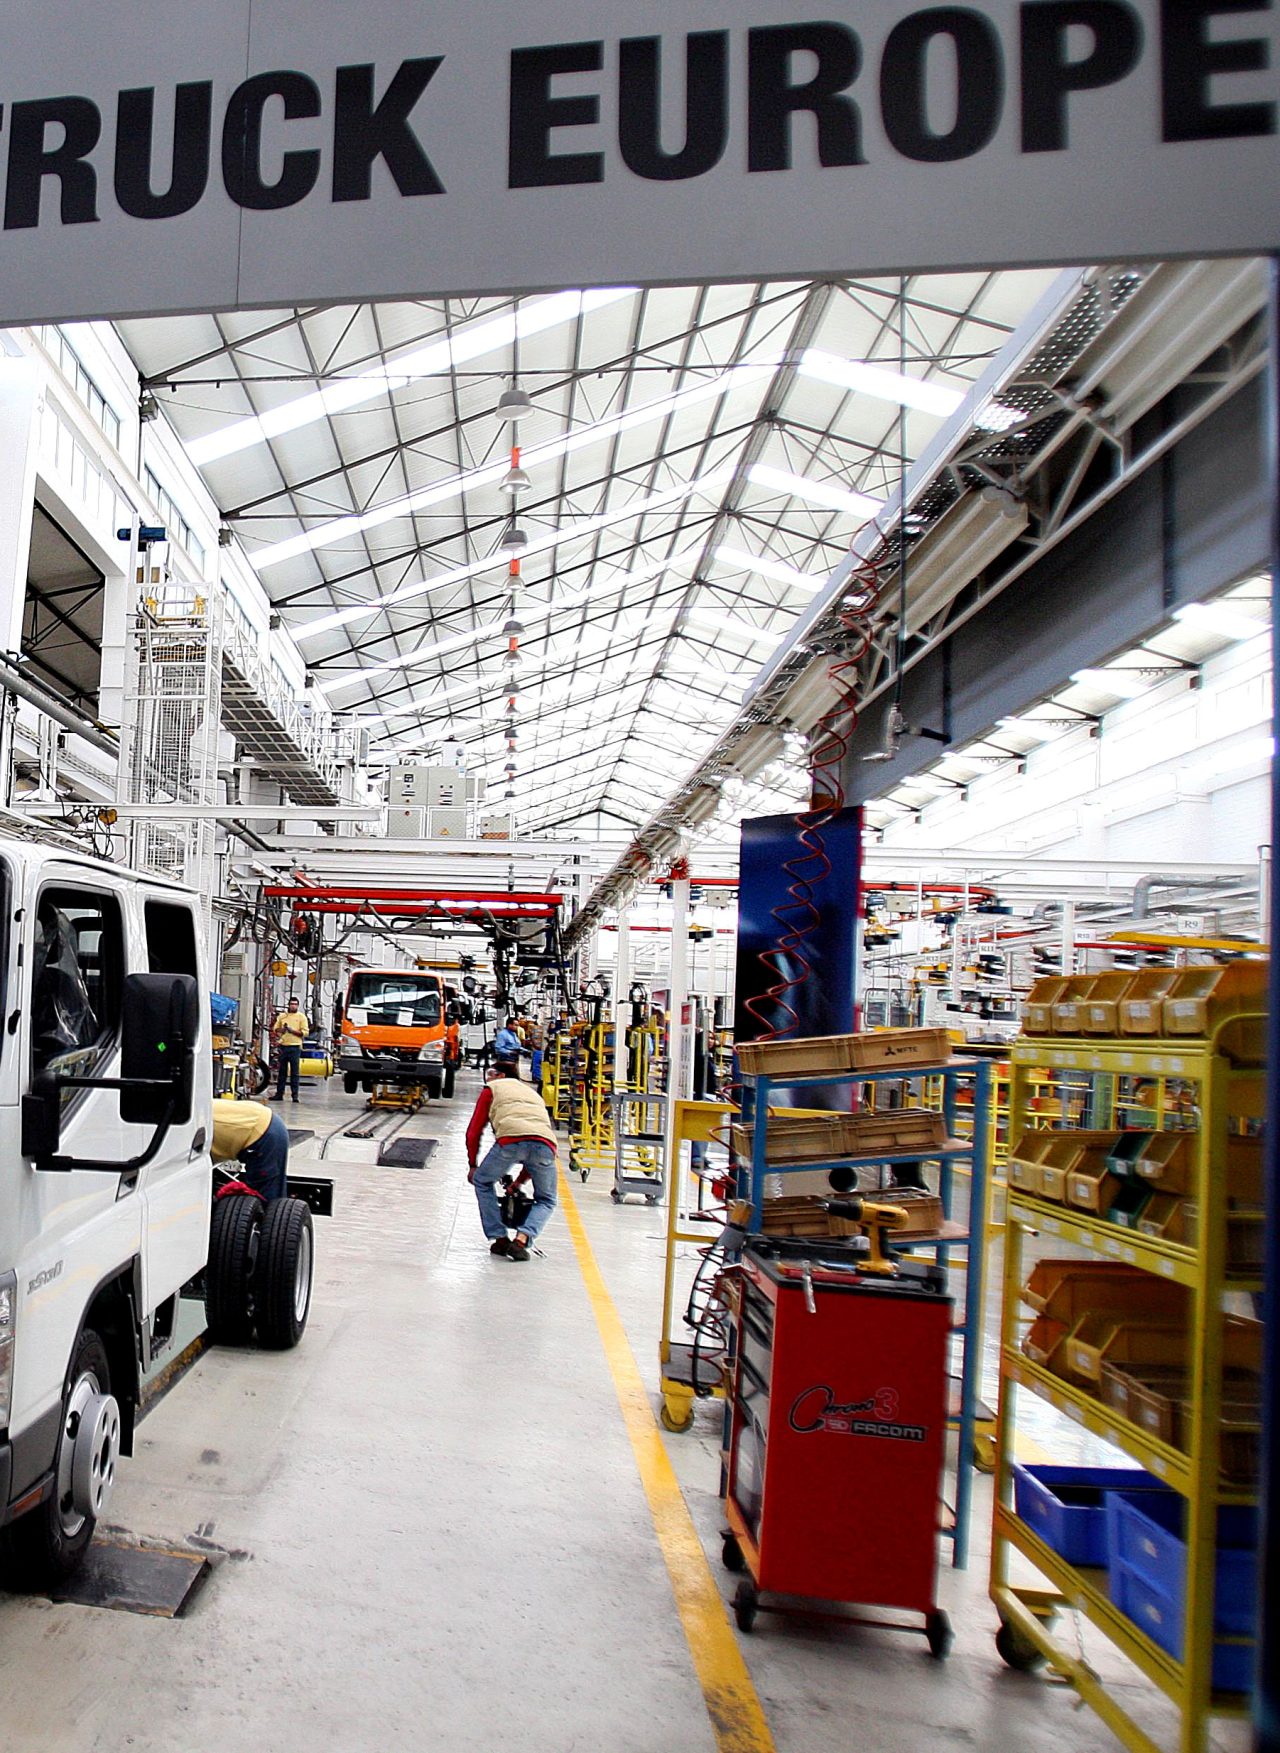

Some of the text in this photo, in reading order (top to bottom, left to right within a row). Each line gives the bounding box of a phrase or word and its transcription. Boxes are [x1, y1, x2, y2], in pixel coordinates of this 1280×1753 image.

[508, 0, 1279, 189] EUROPE
[1184, 920, 1199, 929] R9
[874, 1386, 900, 1421] 3
[852, 1421, 924, 1441] FACOM
